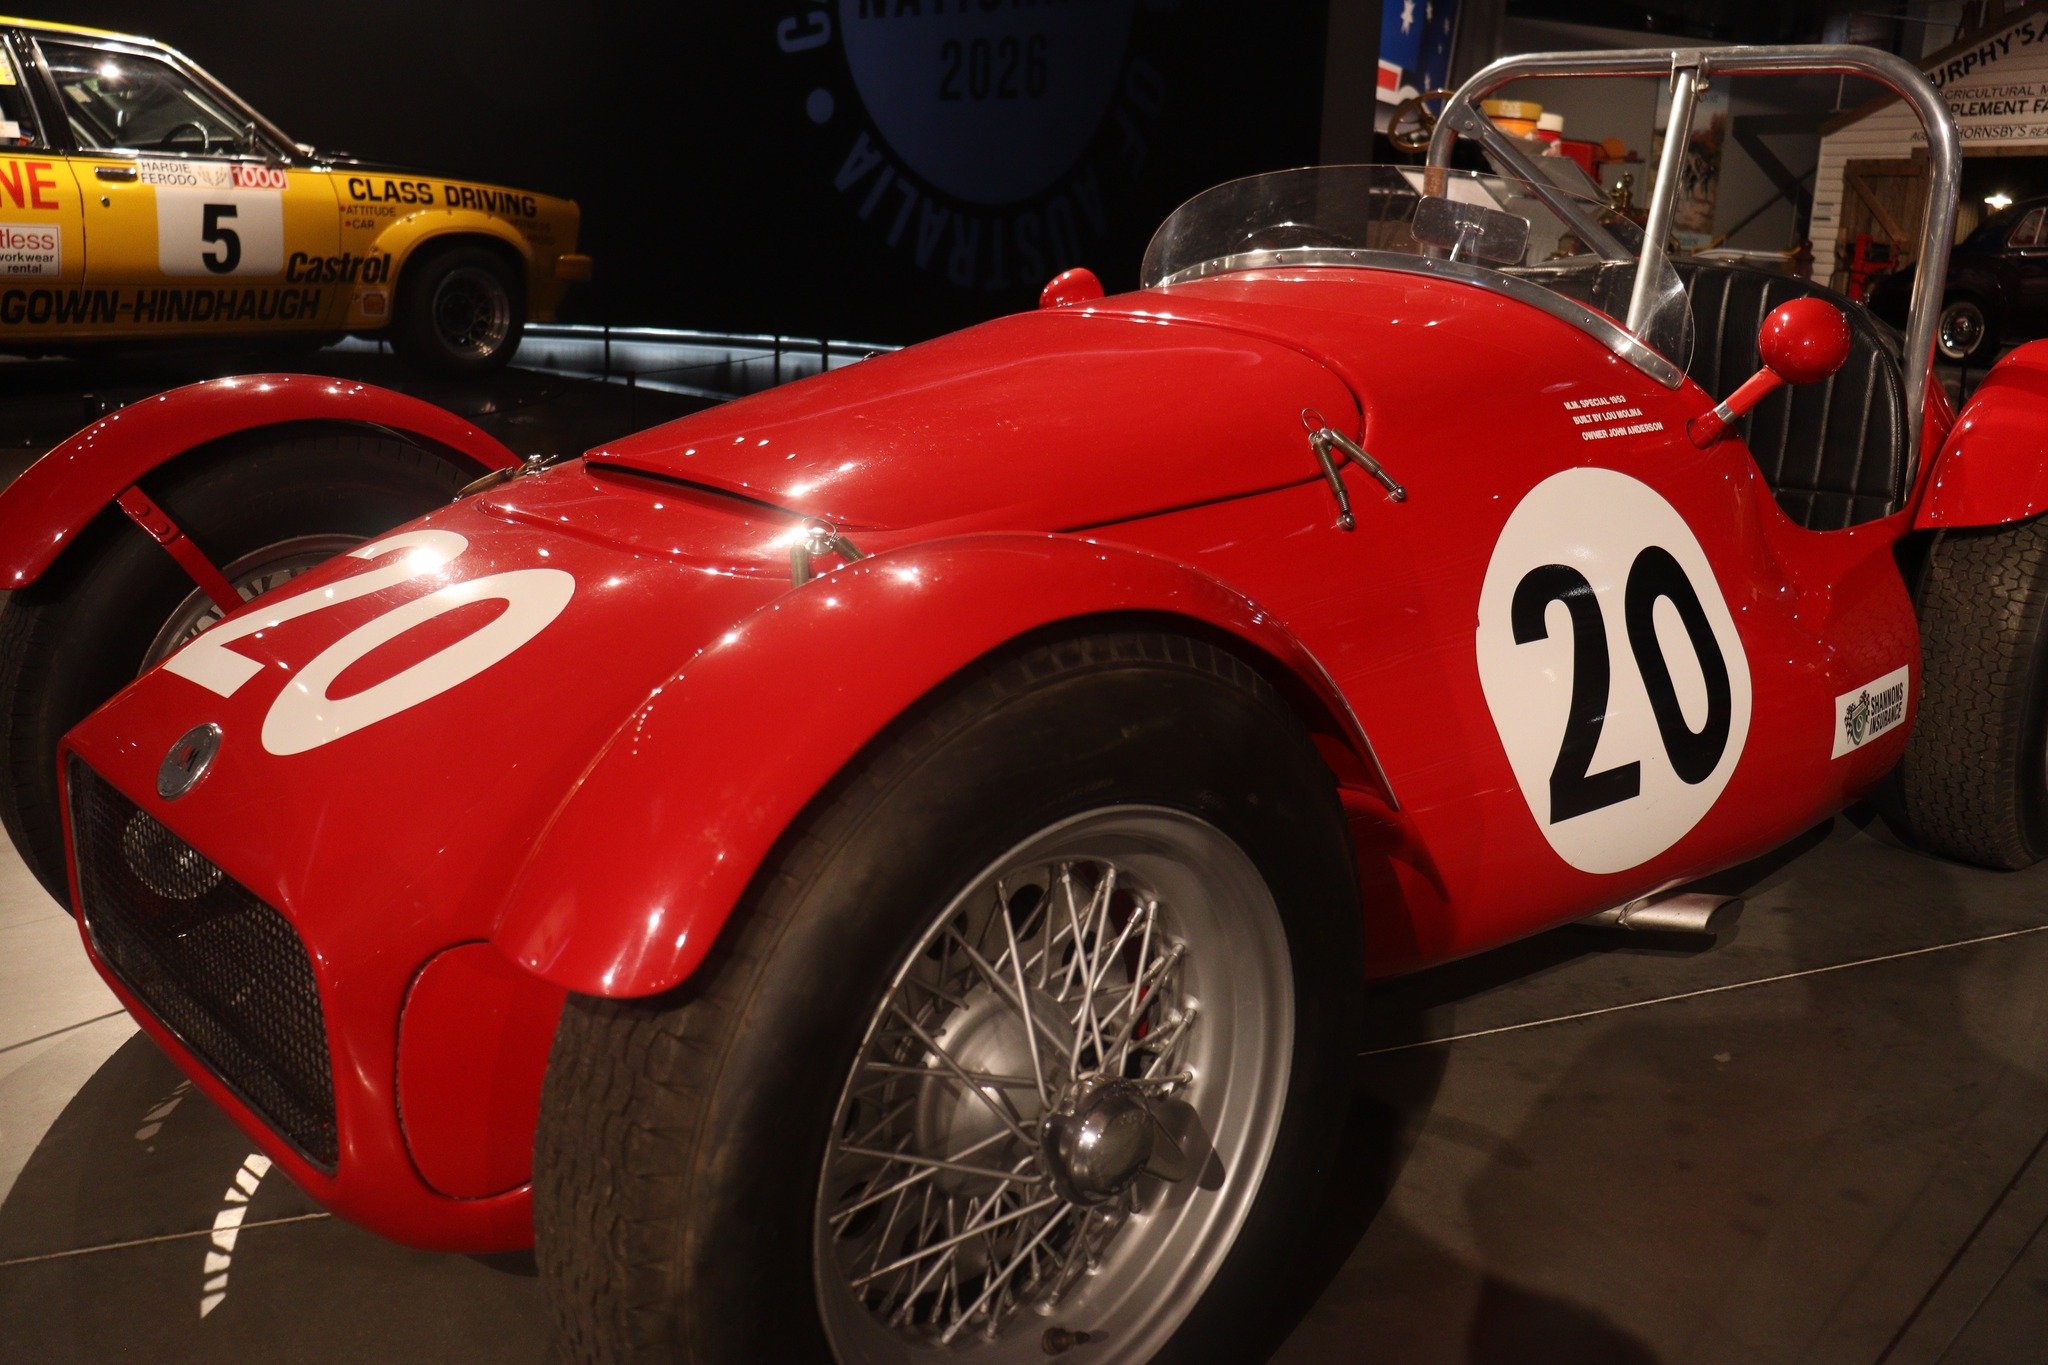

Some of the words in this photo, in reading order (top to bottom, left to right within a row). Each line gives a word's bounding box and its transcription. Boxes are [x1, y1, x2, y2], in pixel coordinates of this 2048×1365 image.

[1925, 22, 2035, 89] URPHY'S
[940, 33, 1048, 101] 2026
[1944, 85, 2034, 100] GRICULTURAL
[1950, 99, 2028, 116] PLEMENT
[141, 162, 192, 173] HARDIE
[232, 166, 284, 188] 1000
[141, 173, 197, 186] FERODO
[349, 178, 434, 205] CLASS
[444, 185, 538, 218] DRIVING
[346, 206, 397, 218] ATTITUDE
[833, 130, 1107, 292] AUSTRALIA
[352, 219, 375, 230] CAR
[202, 203, 241, 274] 5
[8, 264, 42, 273] rental
[286, 252, 392, 285] Castrol
[1580, 397, 1610, 408] SPECIAL
[1573, 414, 1592, 425] BUILT
[1593, 413, 1602, 422] BY
[1602, 411, 1617, 421] LOU
[1618, 408, 1643, 419] MOLINA
[1582, 430, 1608, 441] OWNER
[1609, 427, 1627, 437] JOHN
[1628, 422, 1664, 435] ANDERSON
[162, 529, 576, 756] 20
[1511, 545, 1732, 825] 20
[1871, 682, 1903, 717] SHANNONS
[1869, 701, 1902, 736] INSURANCE
